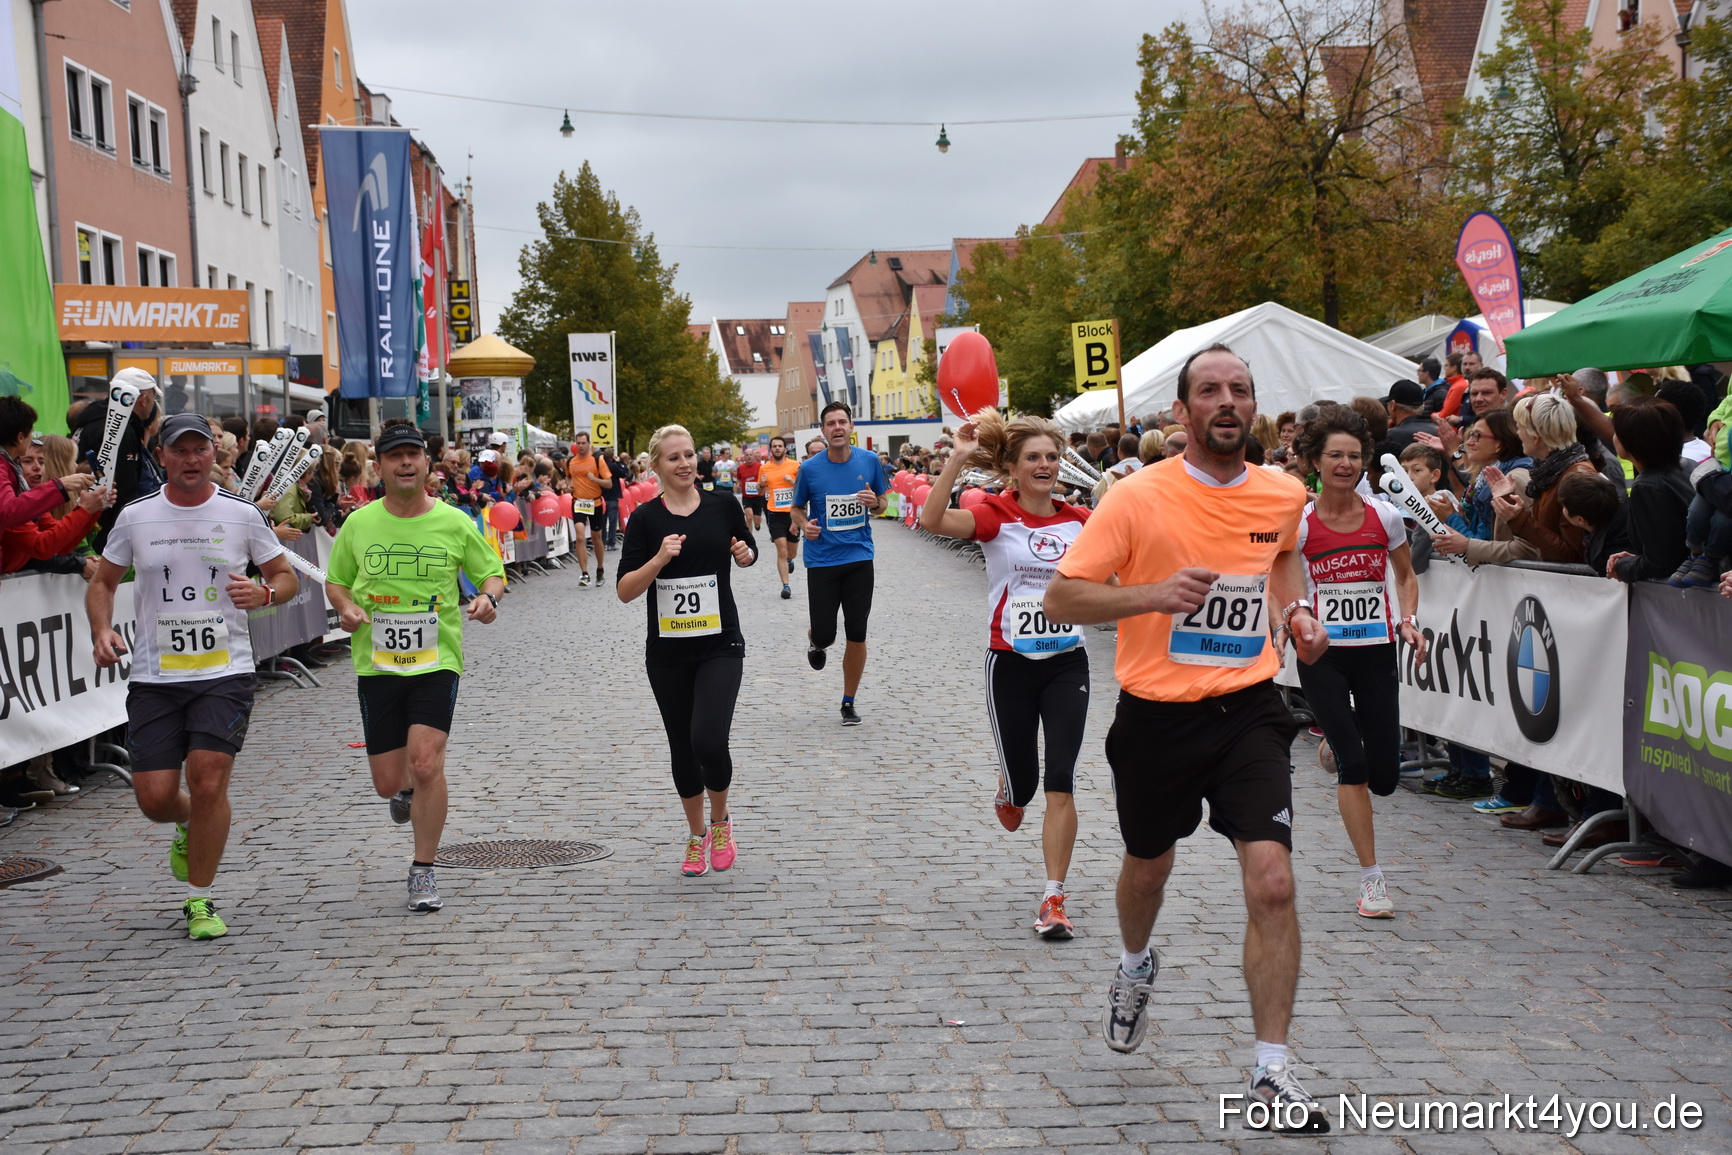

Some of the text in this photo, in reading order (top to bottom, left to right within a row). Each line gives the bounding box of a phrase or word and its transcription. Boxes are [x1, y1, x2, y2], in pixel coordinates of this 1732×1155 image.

[373, 220, 394, 378] RAIL.ONE
[1078, 323, 1113, 338] Block
[1085, 342, 1110, 376] B
[596, 423, 608, 439] C
[284, 445, 300, 468] BMW
[244, 465, 261, 486] BMW
[291, 459, 310, 480] BMW
[831, 502, 863, 517] 2365
[1404, 495, 1435, 526] BMW
[150, 537, 178, 546] weidinger
[1249, 532, 1279, 543] THULE
[1311, 553, 1367, 575] MUSCAT
[1336, 569, 1368, 580] Runners
[676, 582, 707, 590] Neumarkt
[673, 592, 700, 614] 29
[1011, 601, 1035, 609] PARTL
[1326, 597, 1380, 622] 2002
[181, 617, 215, 626] Neumarkt
[373, 617, 393, 625] PARTL
[1183, 596, 1263, 631] 2087
[670, 619, 708, 630] Christina
[171, 627, 216, 653] 516
[384, 627, 423, 650] 351
[1342, 627, 1367, 639] Birgit
[1036, 640, 1059, 651] Steffi
[1200, 638, 1242, 654] Marco
[393, 655, 417, 664] Klaus
[1641, 738, 1692, 775] inspired
[1702, 765, 1731, 795] smart
